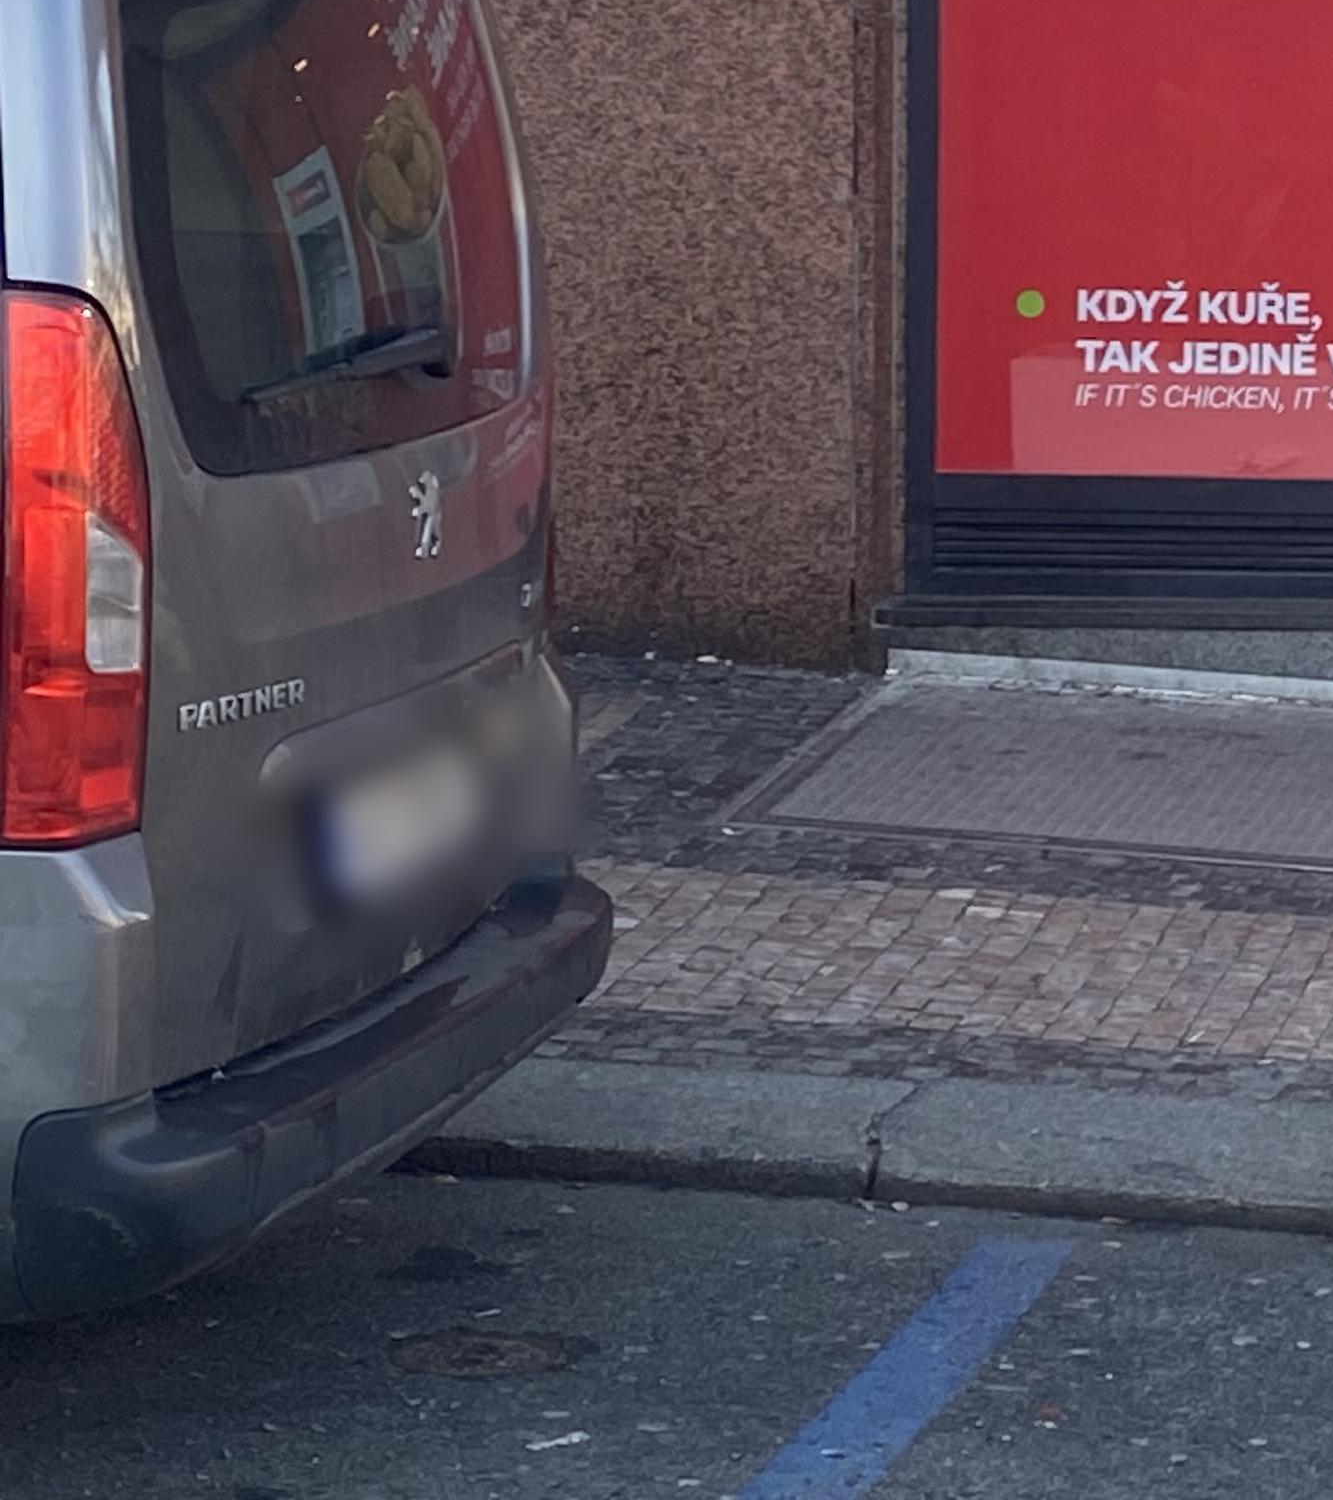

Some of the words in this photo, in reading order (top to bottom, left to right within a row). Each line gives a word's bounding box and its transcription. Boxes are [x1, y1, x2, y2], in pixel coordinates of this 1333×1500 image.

[1077, 280, 1189, 323] KDYŽ
[1199, 283, 1323, 332] KUŘE,
[1075, 340, 1159, 373] TAK
[1168, 334, 1317, 376] JEDINĚ
[1075, 384, 1099, 406] IF
[1164, 385, 1285, 414] CHICKEN,
[178, 678, 305, 731] PARTNER
